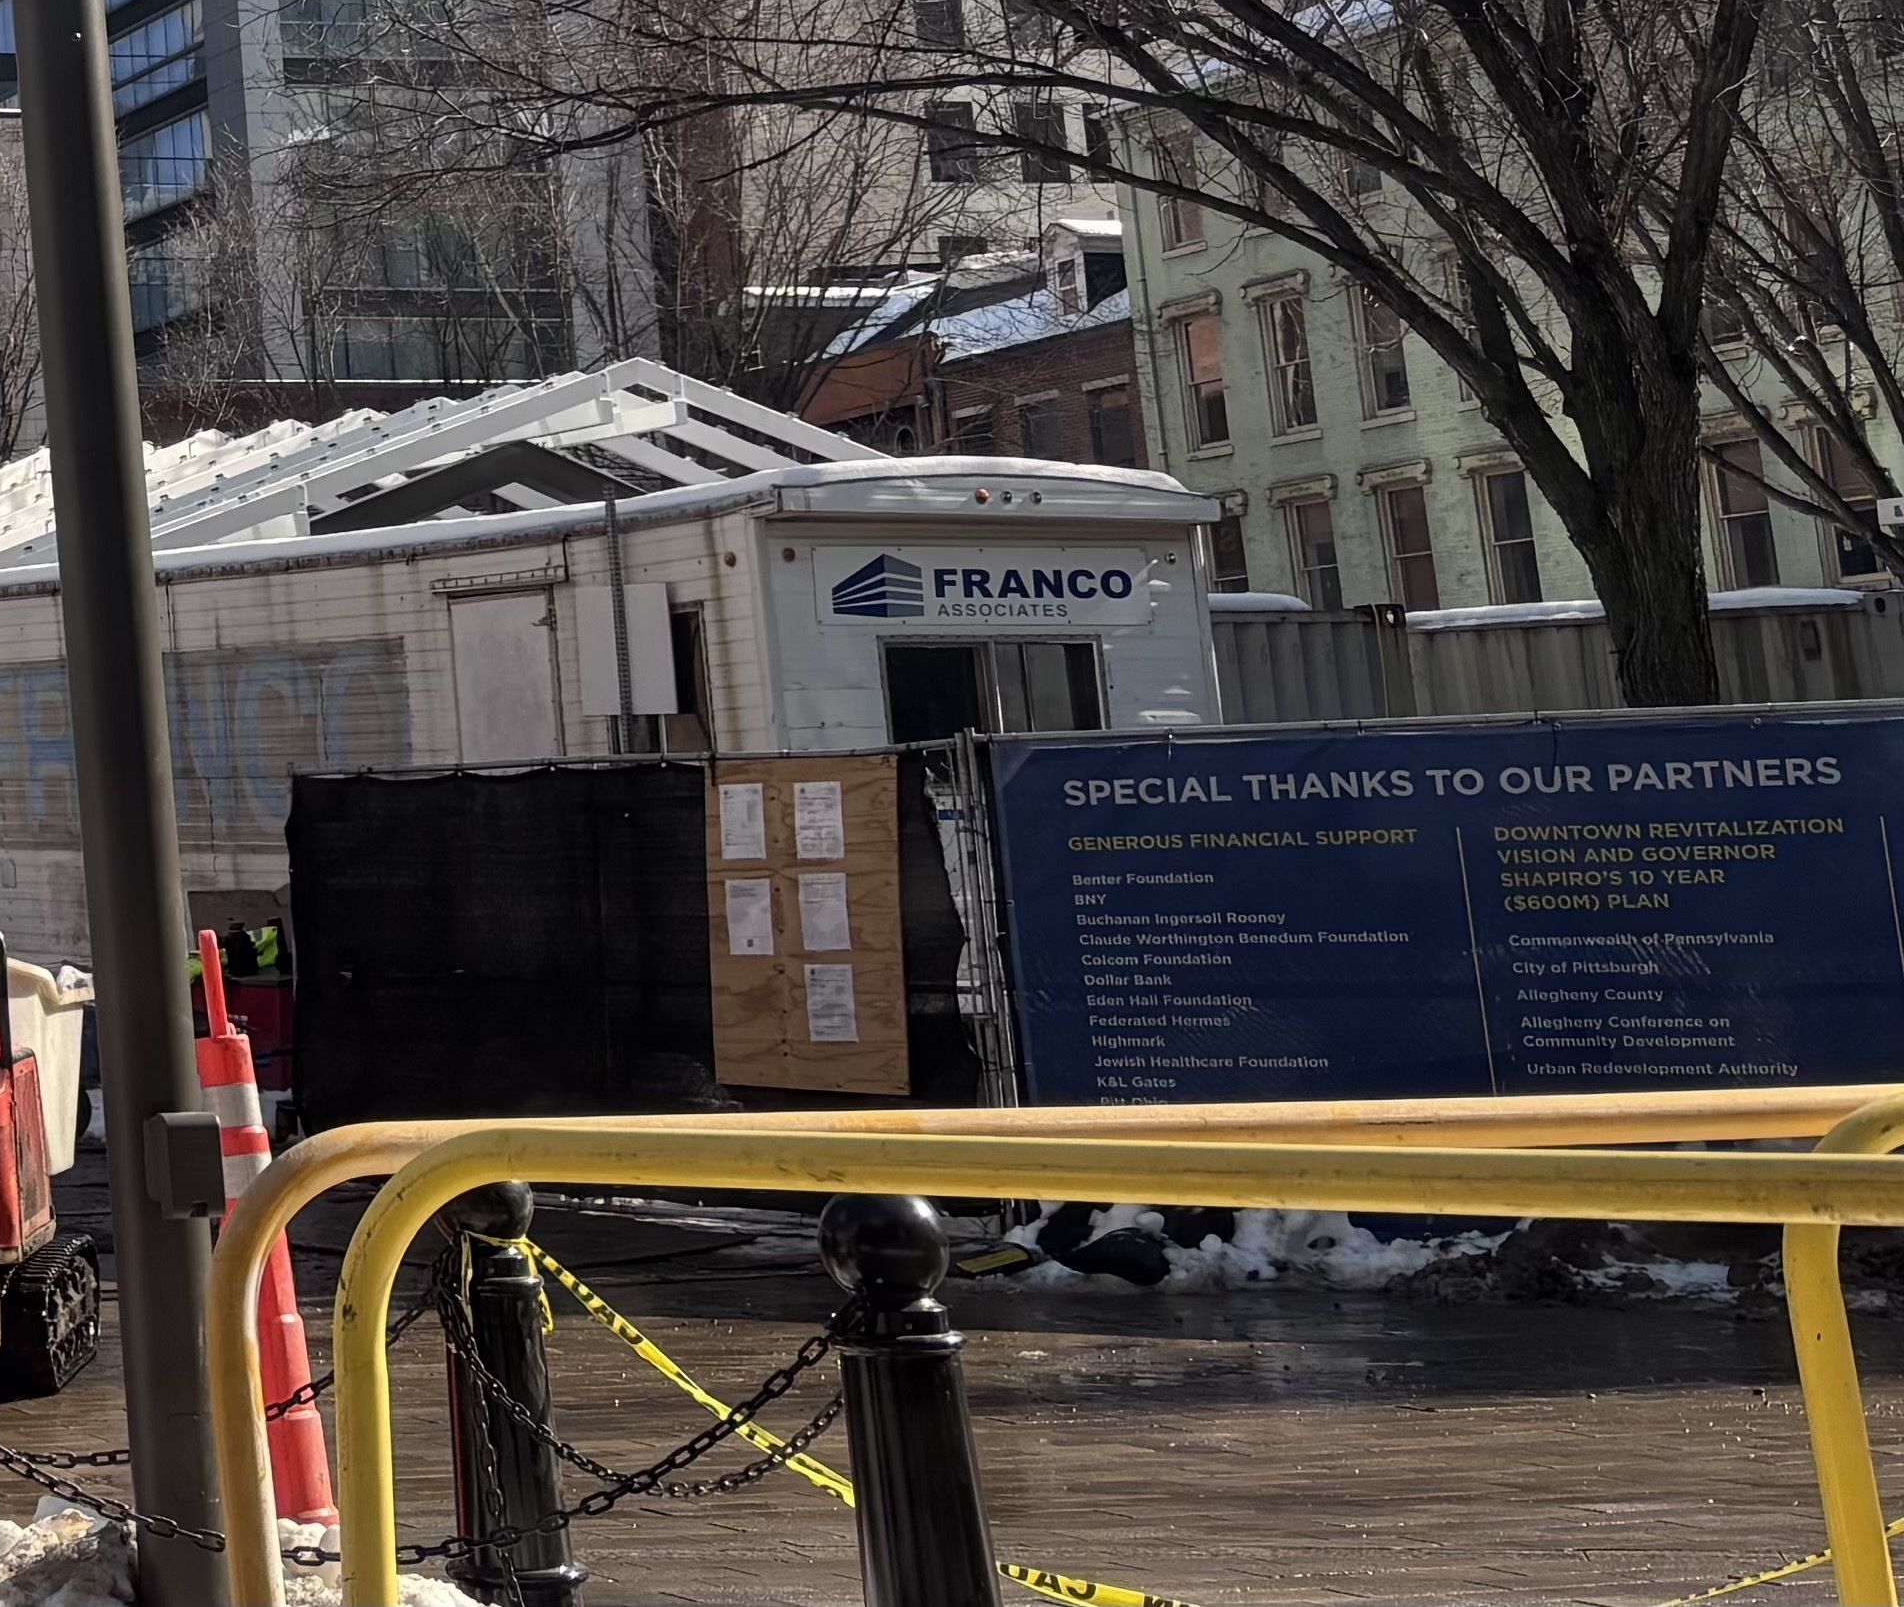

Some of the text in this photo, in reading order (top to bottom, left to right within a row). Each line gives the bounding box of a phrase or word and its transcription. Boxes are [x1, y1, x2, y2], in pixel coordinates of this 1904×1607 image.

[933, 568, 1133, 600] FRANCO
[937, 603, 1069, 618] ASSOCIATES
[1063, 757, 1842, 806] SPECIAL THANKS TO OUR PARTNERS
[1494, 818, 1844, 842] DOWNTOWN REVITALIZATION
[1068, 828, 1418, 851] GENEROUS FINANCIAL SUPPORT
[1497, 844, 1776, 865] VISION AND GOVERNOR
[1072, 872, 1214, 886] Benter Foundation
[1500, 869, 1725, 887] SHAPIRO'S 10 YEAR
[1074, 894, 1106, 905] BNY
[1503, 893, 1670, 912] ($600M) PLAN
[1076, 911, 1286, 927] Buchanan Ingersoll Rooney
[1079, 930, 1409, 947] Claude Worthington Benedum Foundation
[1508, 931, 1775, 947] Commonwealth of Pennsylvania
[1081, 953, 1232, 966] Colcom Foundation
[1512, 960, 1659, 977] City of Pittsburgh
[1084, 973, 1172, 986] Dollar Bank
[1087, 993, 1252, 1007] Eden Hall Foundation
[1517, 988, 1664, 1003] Allegheny County
[1089, 1014, 1231, 1027] Federated Hermes
[1521, 1015, 1730, 1031] Allegheny Conference on
[1092, 1035, 1166, 1049] Highmark
[1523, 1034, 1736, 1050] Community Development
[1095, 1055, 1328, 1068] Jewish Healthcare Foundation
[1527, 1061, 1799, 1077] Urban Redevelopment Authority
[1097, 1076, 1176, 1088] K&L Gates
